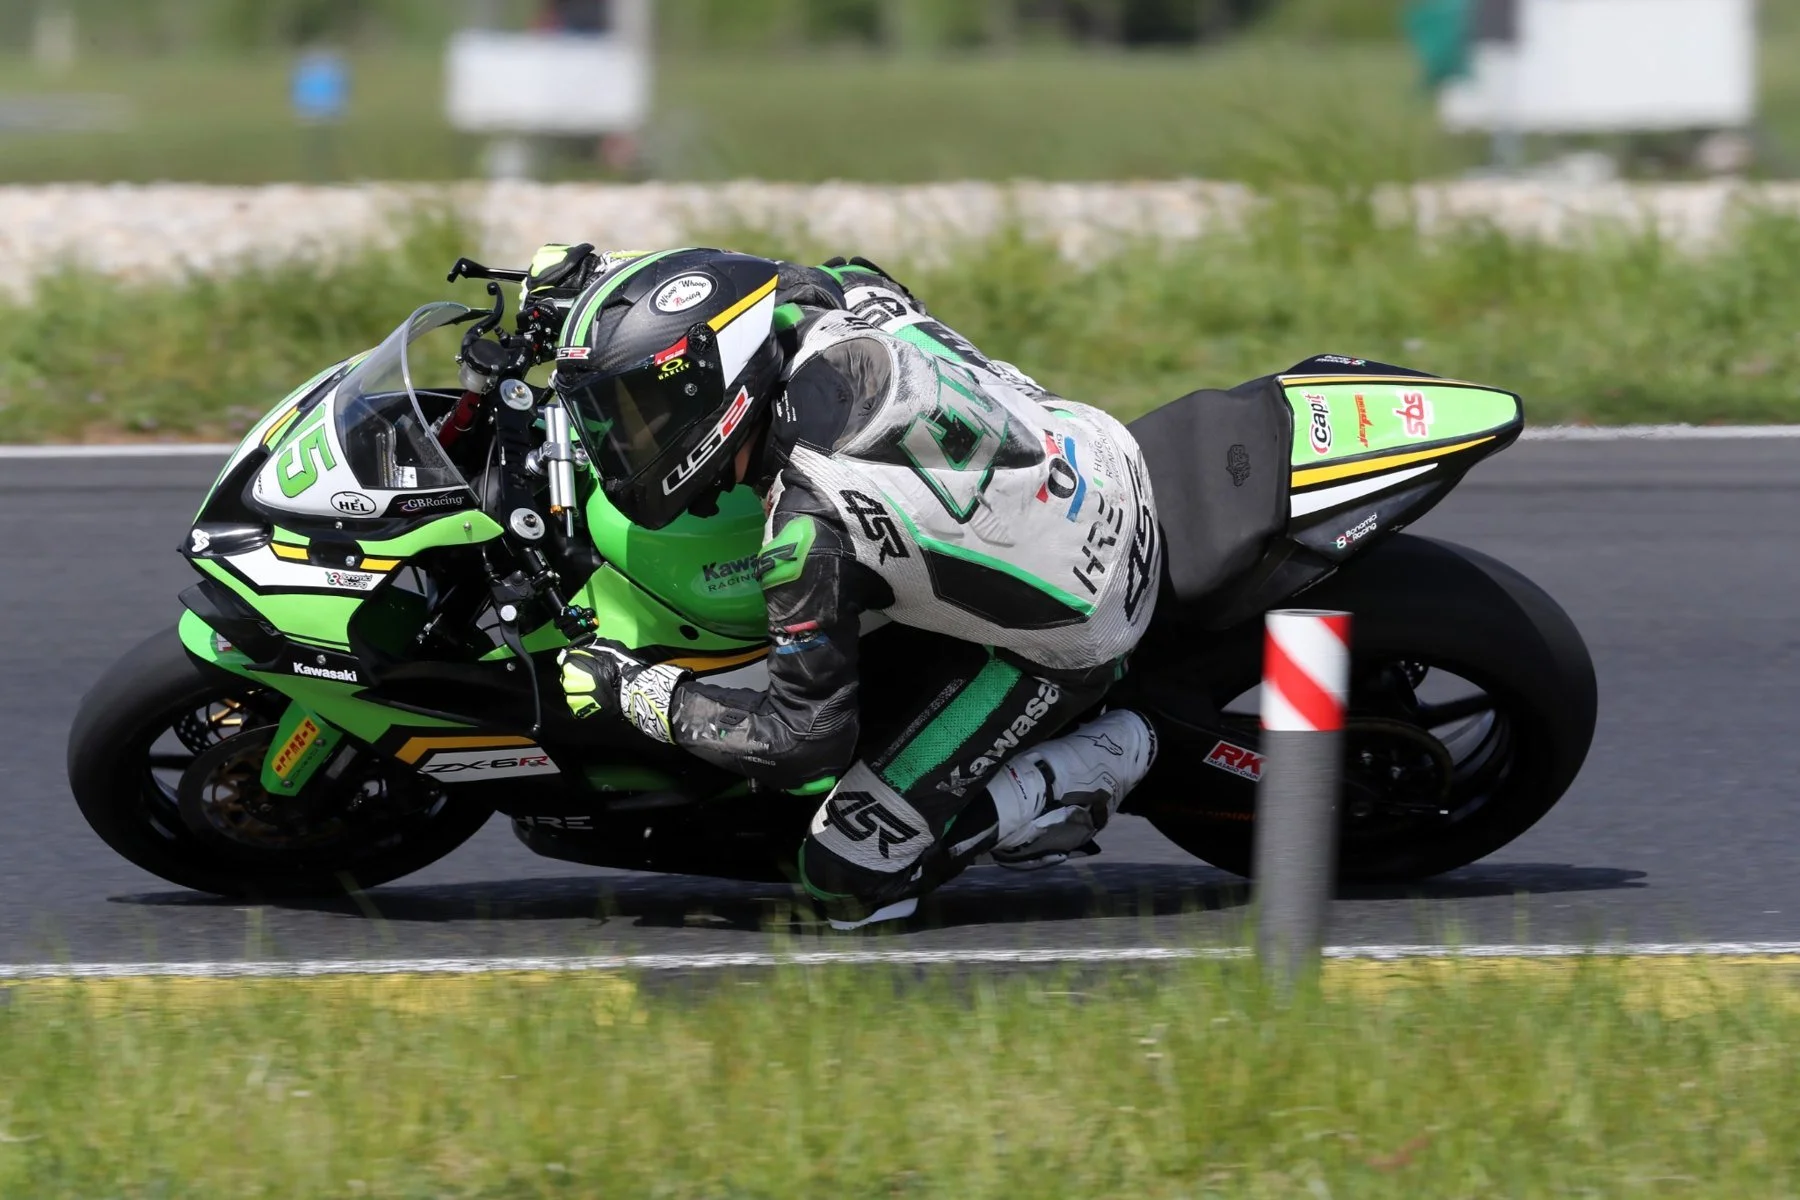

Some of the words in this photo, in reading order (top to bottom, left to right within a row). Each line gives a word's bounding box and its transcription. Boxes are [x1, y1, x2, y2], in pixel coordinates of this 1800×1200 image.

[662, 386, 754, 496] LS2
[339, 501, 370, 512] HEL
[407, 496, 463, 508] GBRacing
[839, 489, 911, 565] 4SR
[1072, 491, 1124, 595] HRE
[293, 661, 357, 683] Kawasaki
[425, 755, 549, 773] ZX-6R
[1211, 743, 1263, 775] RK
[516, 814, 596, 831] HRE
[823, 791, 921, 859] 4SR
